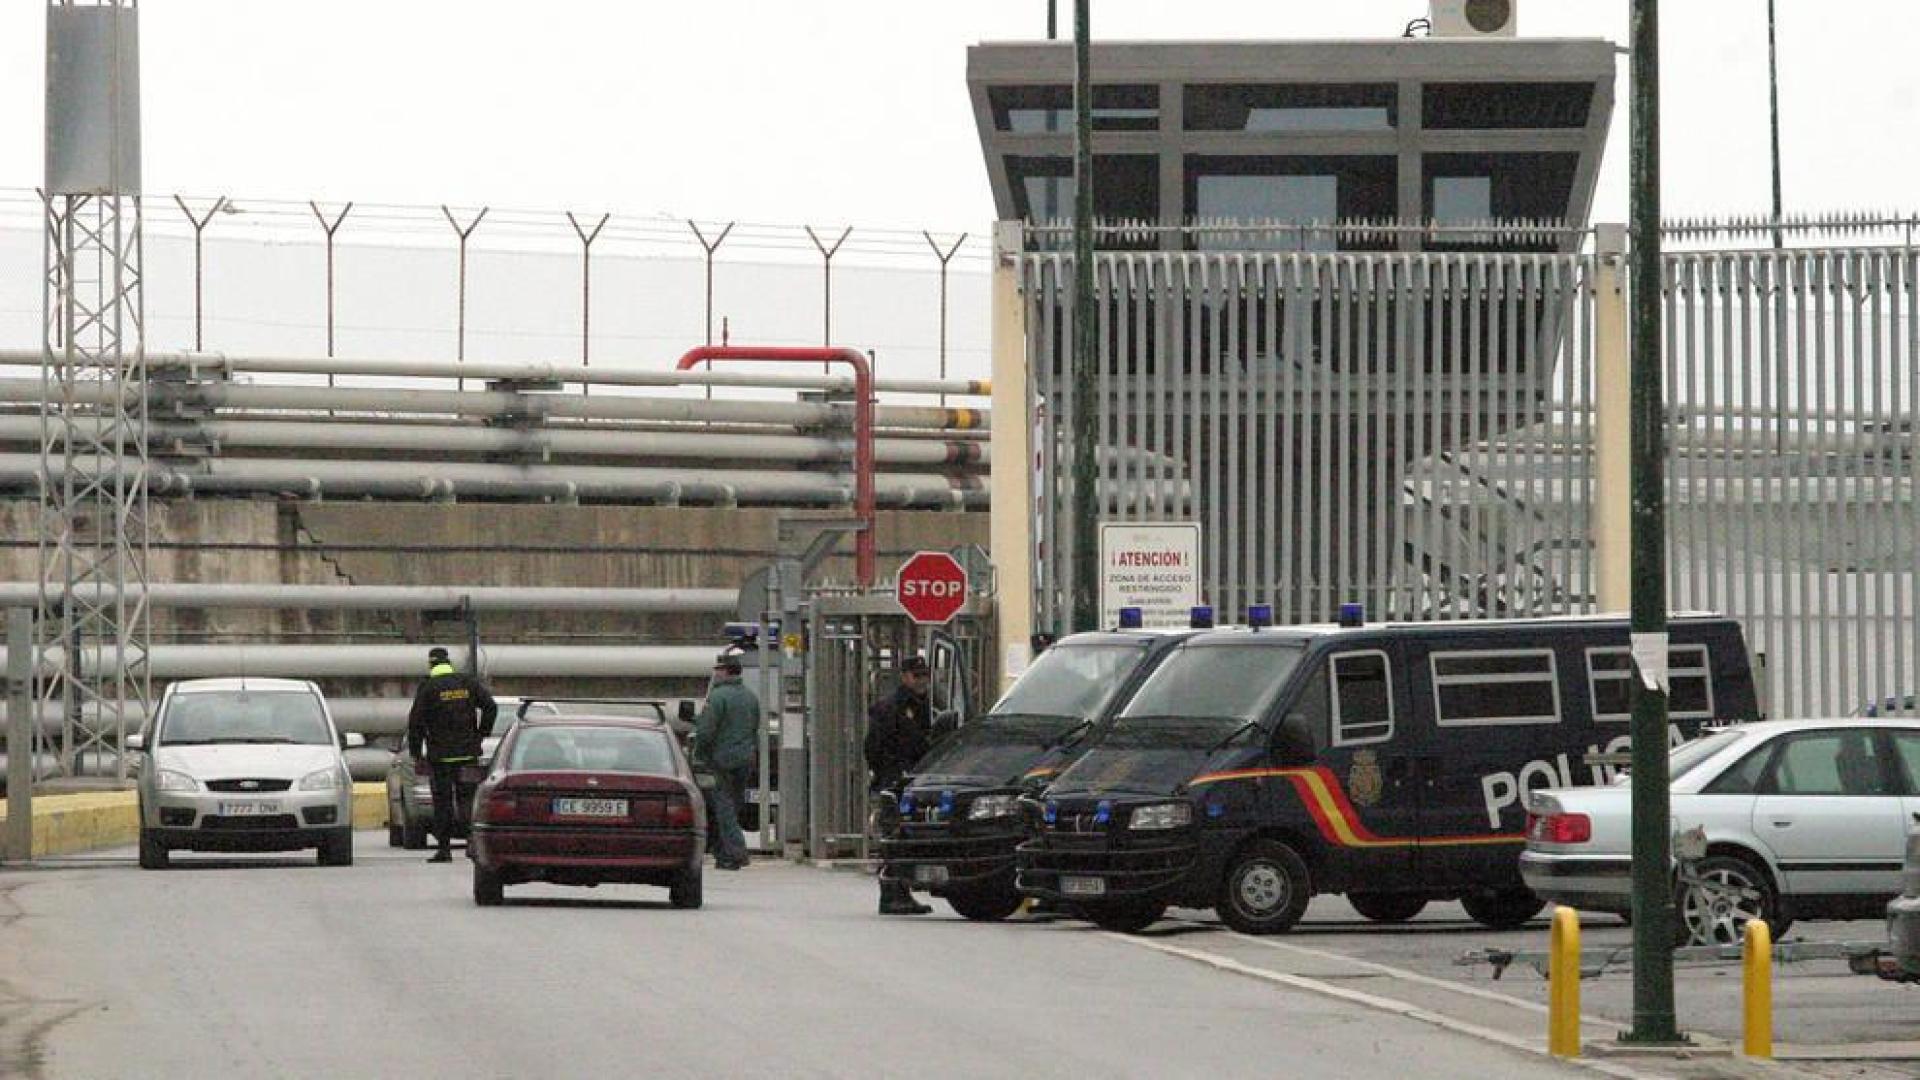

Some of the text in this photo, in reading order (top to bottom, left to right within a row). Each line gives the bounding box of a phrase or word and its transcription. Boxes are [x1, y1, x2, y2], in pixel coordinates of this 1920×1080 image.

[1109, 574, 1192, 582] ZONA DE ACCESO
[903, 579, 961, 598] STOP
[1481, 722, 1685, 829] POLICA
